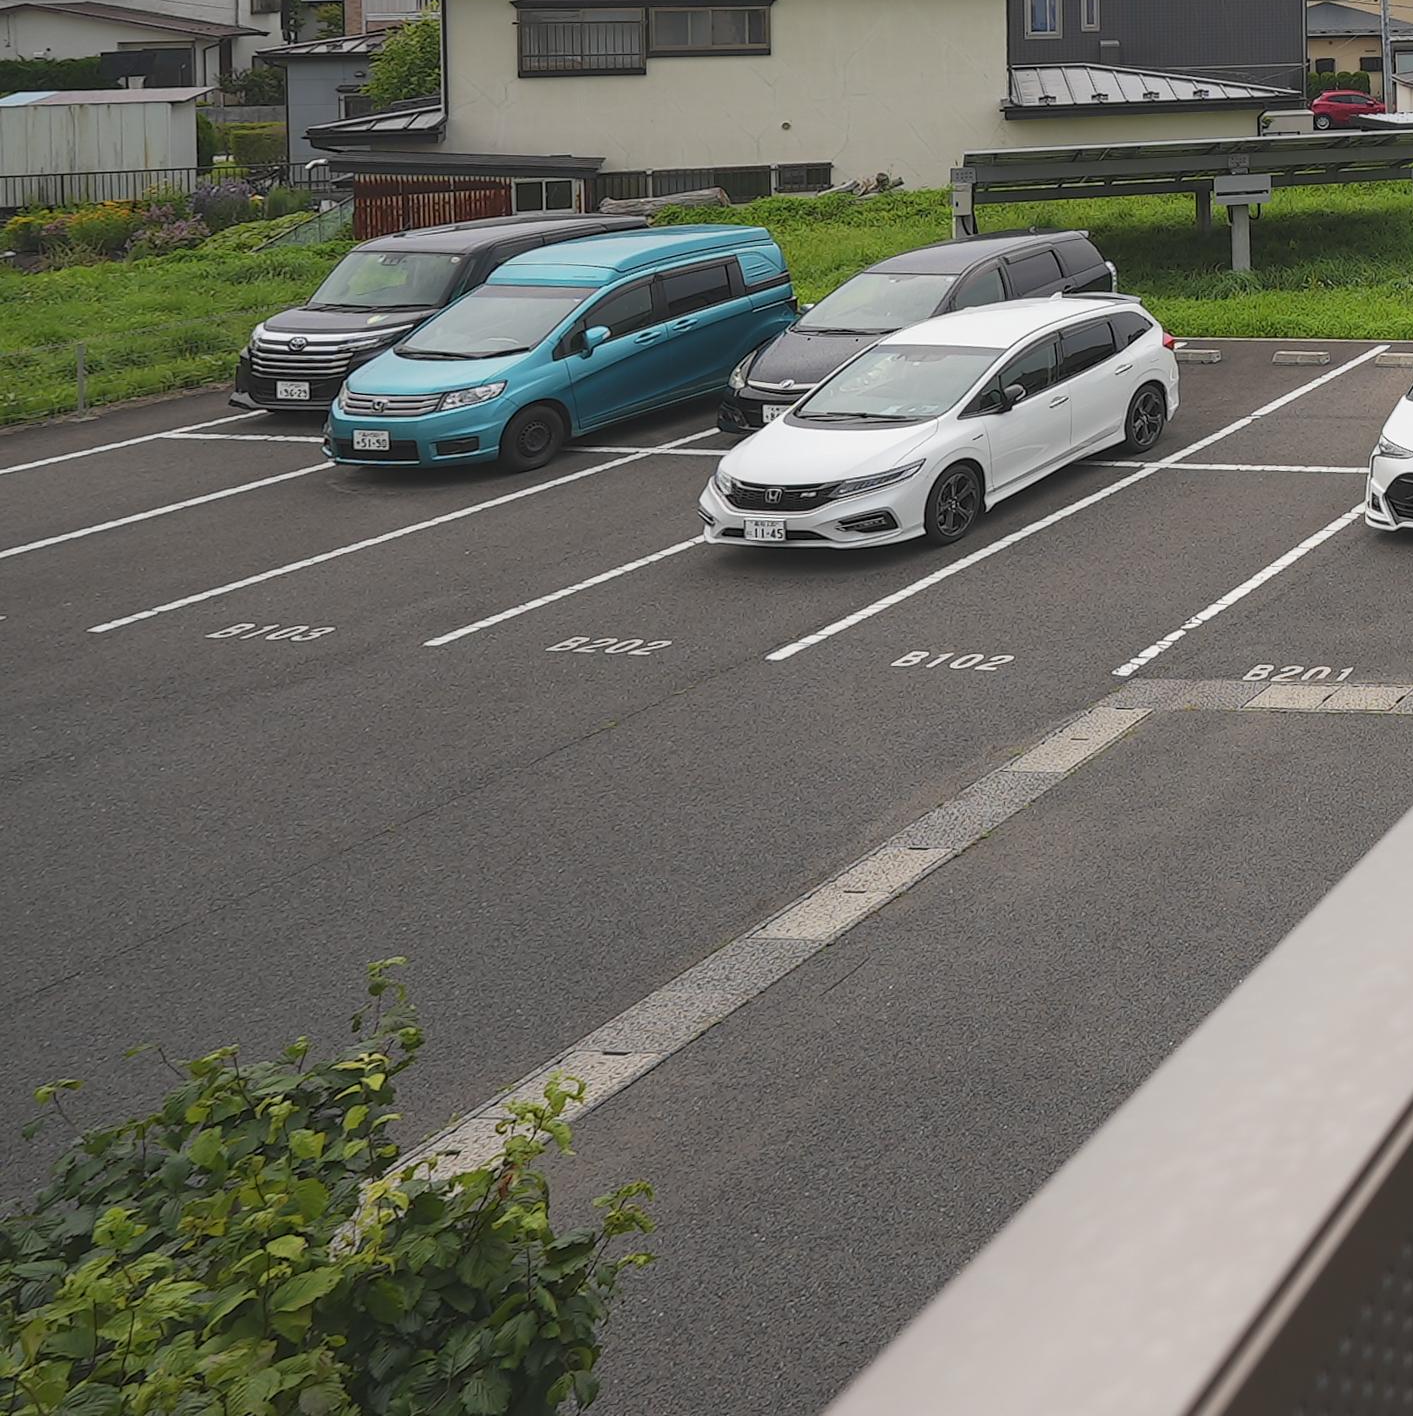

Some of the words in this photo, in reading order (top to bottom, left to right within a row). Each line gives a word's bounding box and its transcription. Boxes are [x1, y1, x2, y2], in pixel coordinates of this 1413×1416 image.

[754, 527, 784, 539] 11-45
[204, 623, 336, 641] B103
[545, 636, 673, 655] B202
[890, 650, 1015, 671] B102
[1242, 664, 1354, 682] B201
